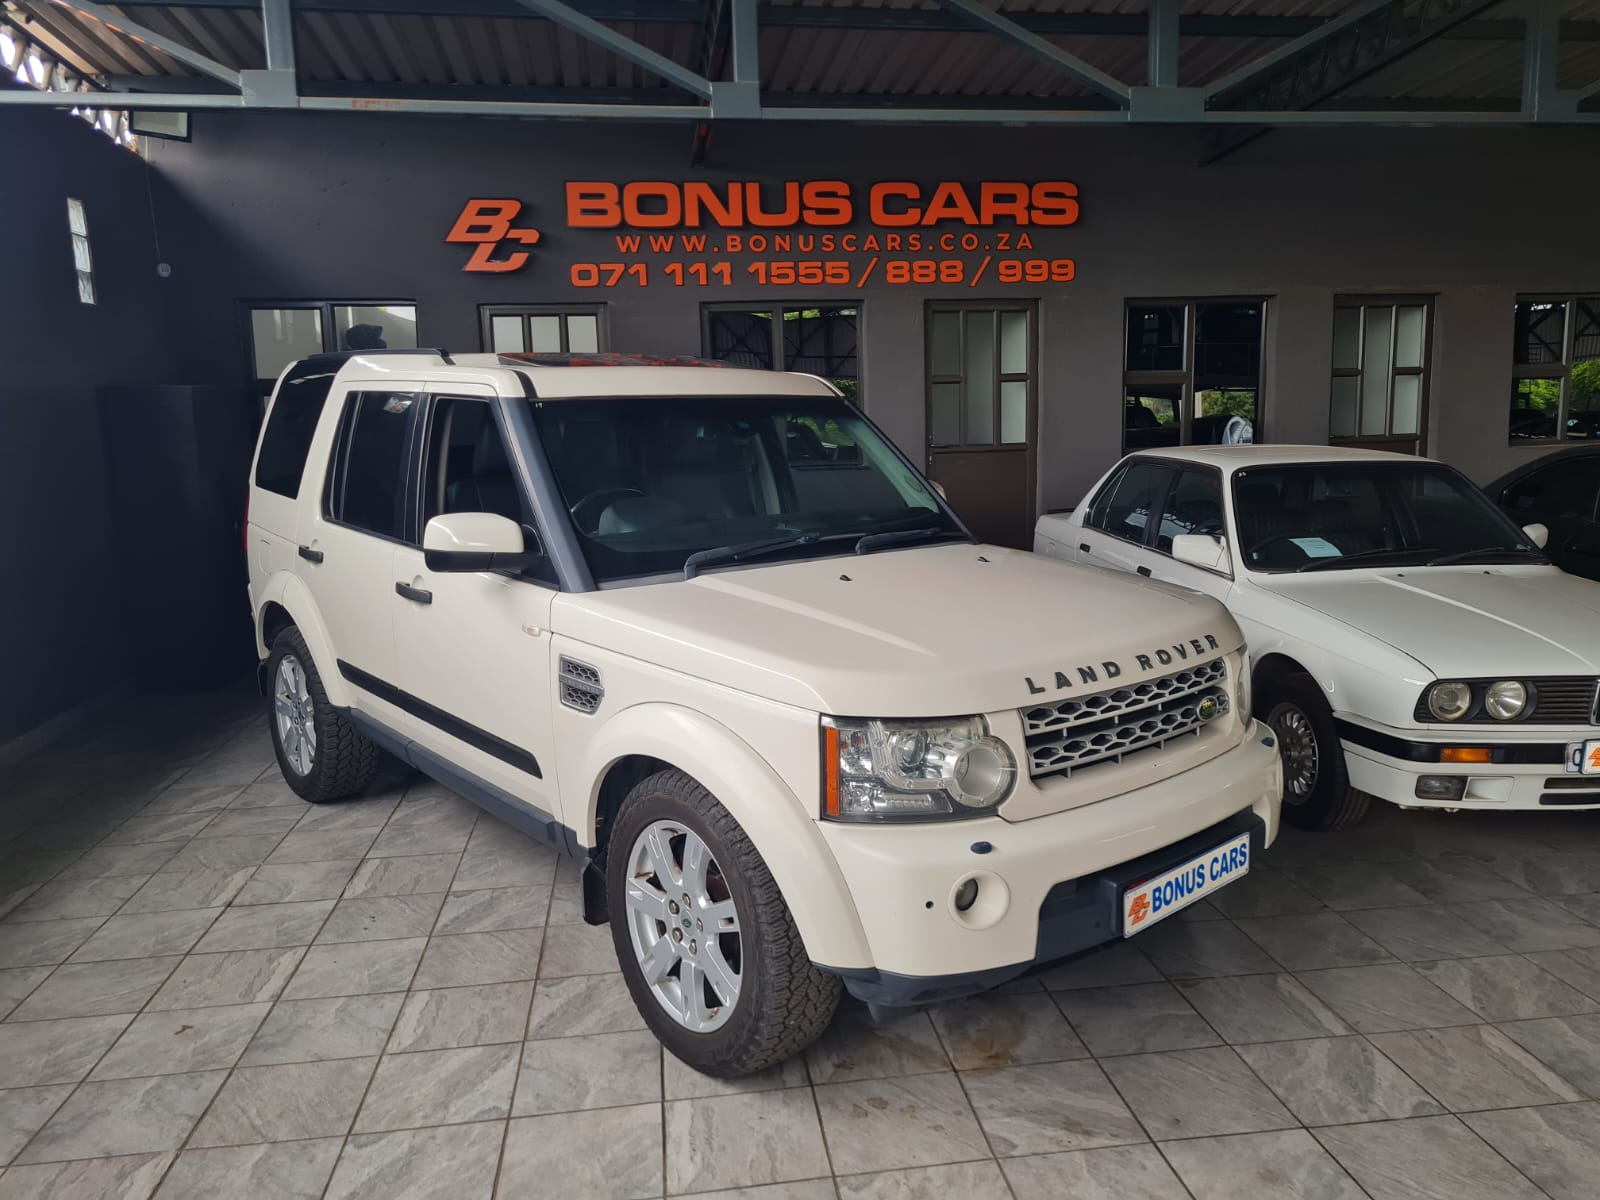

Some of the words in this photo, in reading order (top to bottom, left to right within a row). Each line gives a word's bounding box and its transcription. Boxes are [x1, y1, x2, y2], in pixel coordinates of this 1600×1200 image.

[565, 181, 853, 228] BONUS
[870, 181, 1079, 226] CARS
[615, 233, 1034, 253] WWW.BONUSCARS.CO.ZA
[570, 262, 649, 287] 071
[663, 261, 732, 286] 111
[1025, 661, 1122, 694] LAND
[1135, 634, 1220, 671] ROVER
[1152, 863, 1205, 913] BONUS
[1209, 843, 1247, 882] CARS
